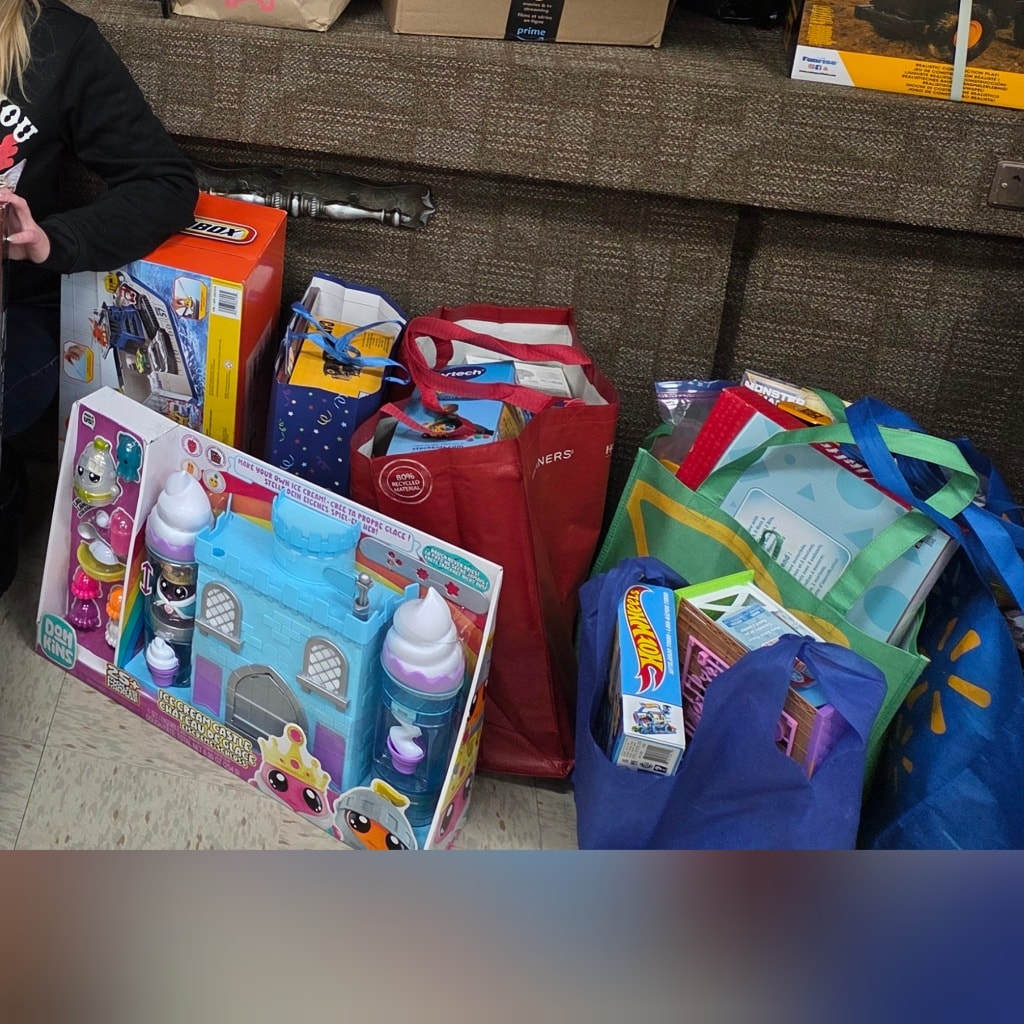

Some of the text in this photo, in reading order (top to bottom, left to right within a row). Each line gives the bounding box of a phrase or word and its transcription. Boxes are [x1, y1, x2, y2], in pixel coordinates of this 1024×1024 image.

[517, 27, 546, 37] prime
[802, 56, 839, 65] Funrise
[536, 450, 573, 466] NERS
[396, 473, 415, 481] 80%
[238, 459, 255, 470] MAKE
[255, 465, 273, 480] YOUR
[274, 475, 290, 488] OWN
[291, 483, 301, 492] ICE
[303, 487, 326, 504] CREAM!
[348, 508, 357, 518] TA
[358, 512, 383, 530] PROPRE
[385, 524, 406, 540] GLACE
[287, 489, 301, 501] DEIN
[303, 494, 329, 514] EIGENES
[106, 664, 140, 690] 25+
[159, 690, 253, 751] ICE CREAM CASTLE
[207, 728, 220, 744] DE
[223, 739, 257, 765] GLACE
